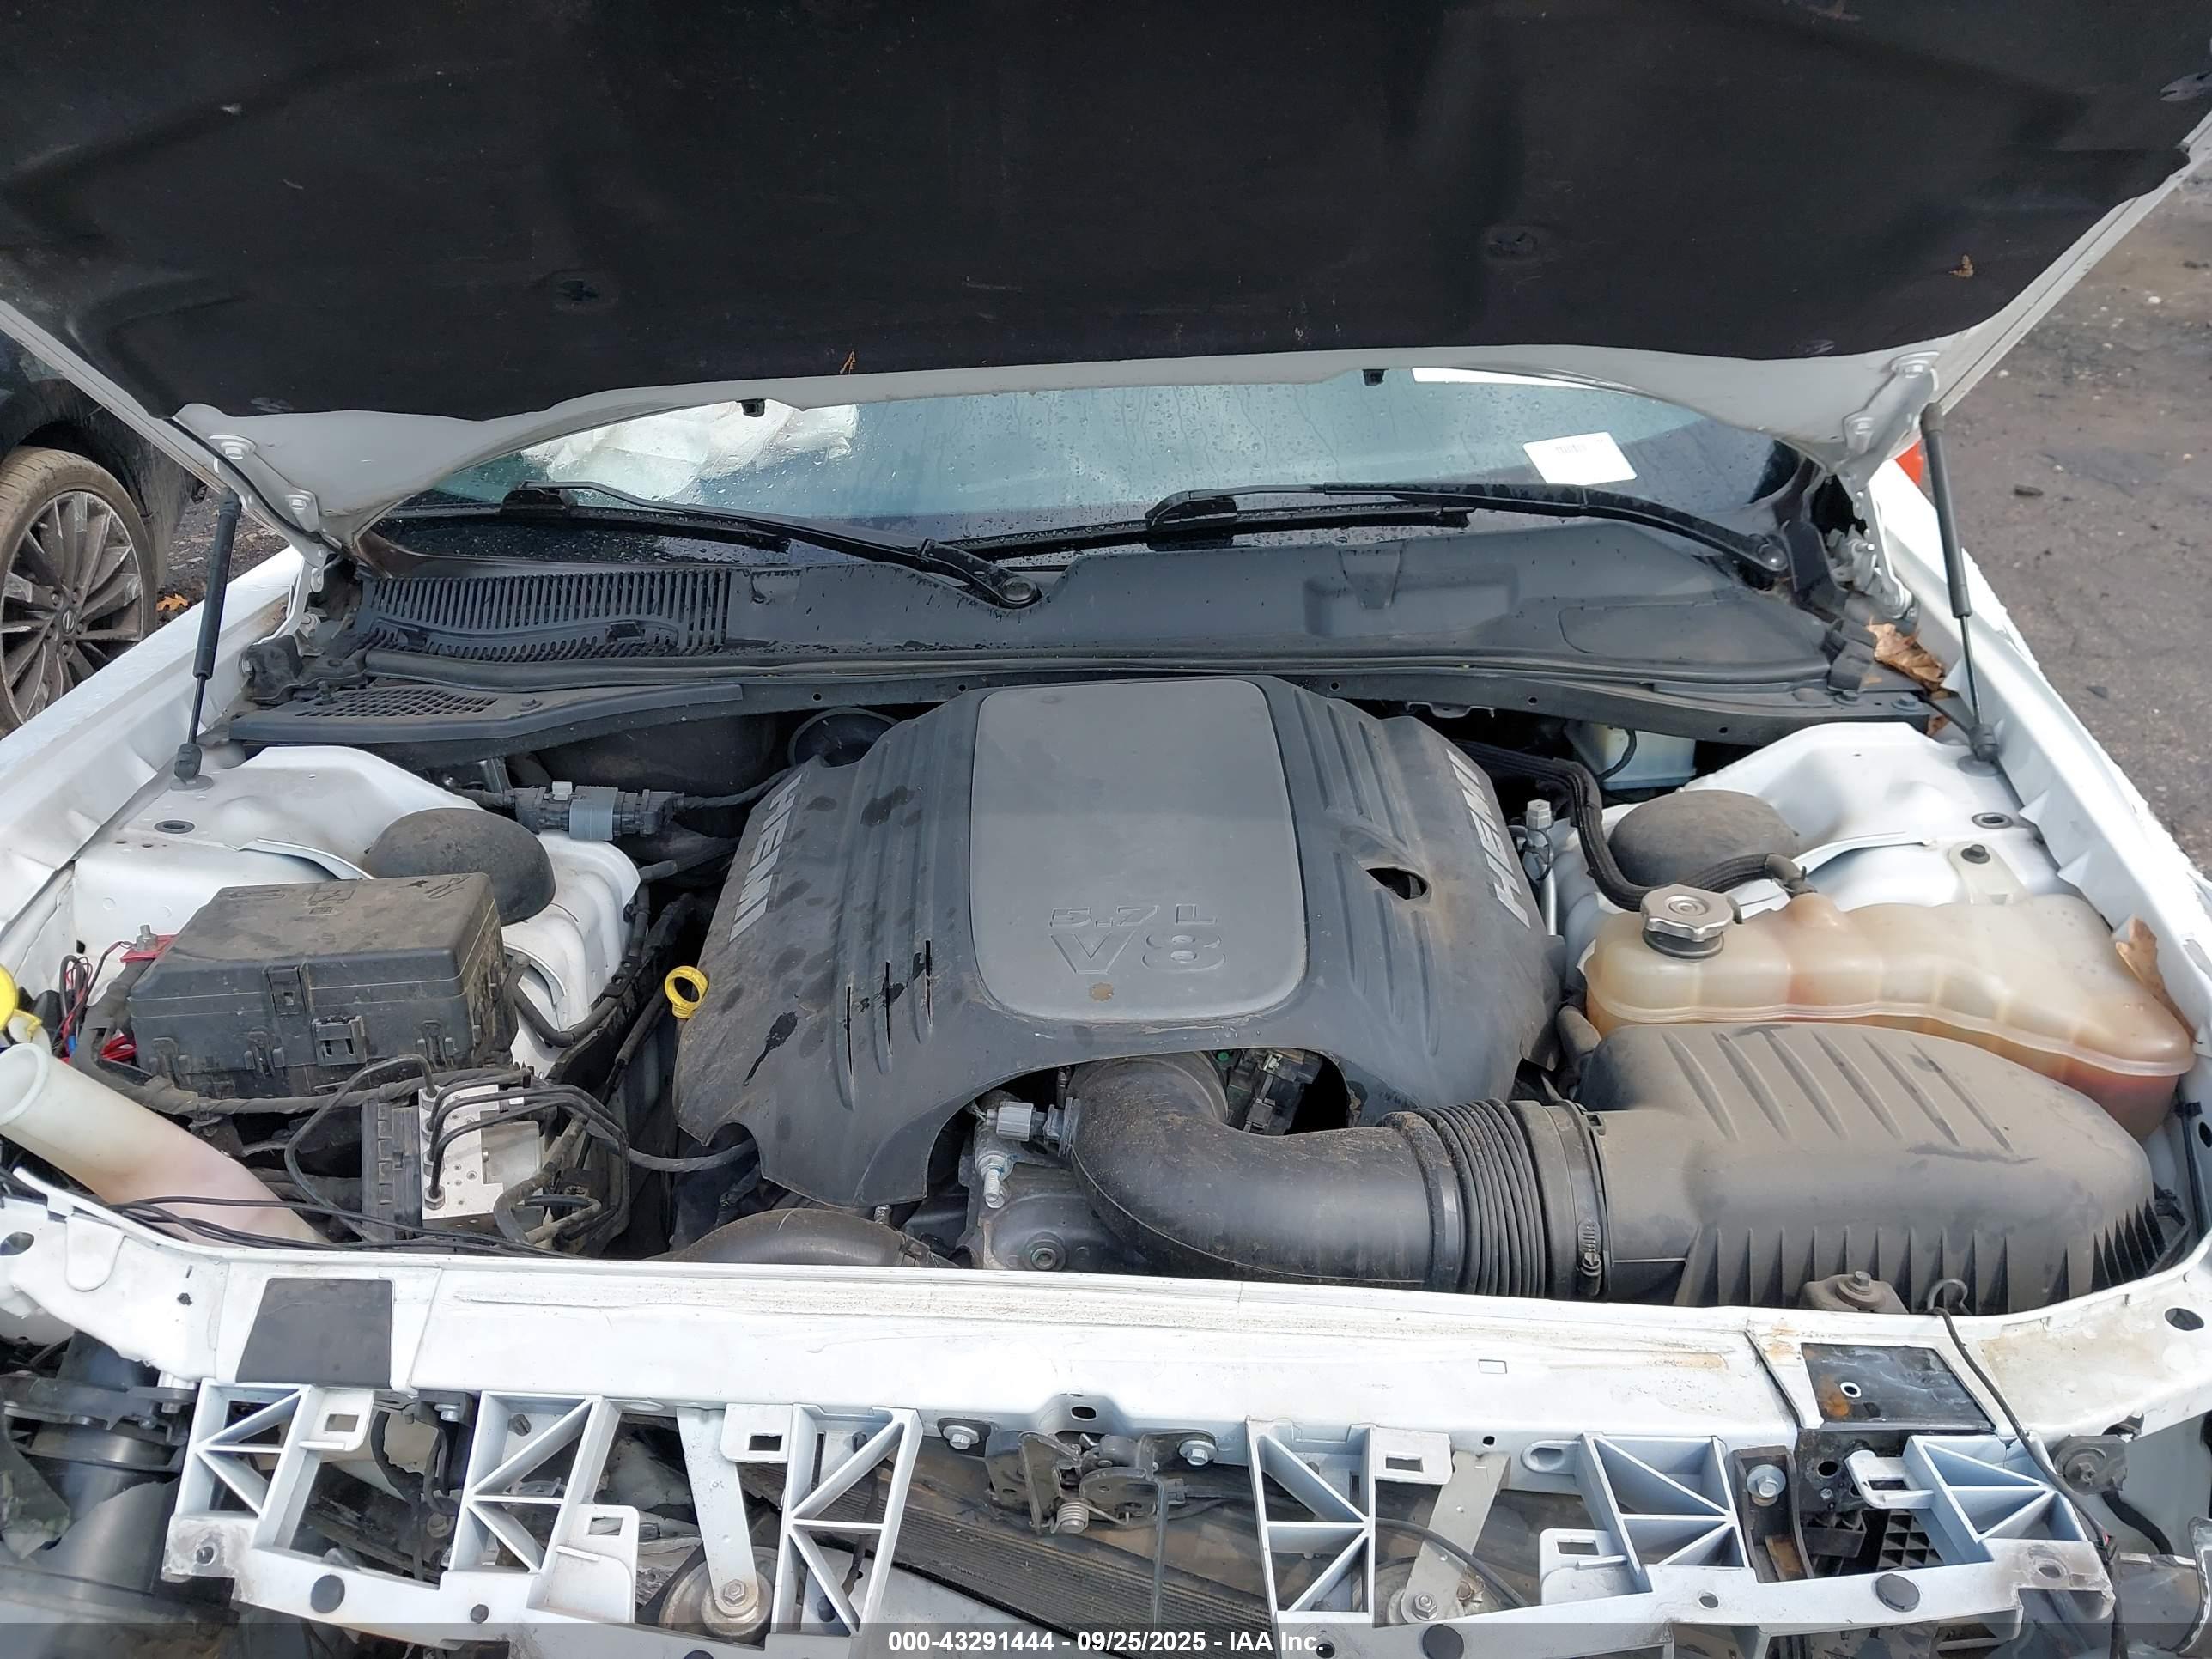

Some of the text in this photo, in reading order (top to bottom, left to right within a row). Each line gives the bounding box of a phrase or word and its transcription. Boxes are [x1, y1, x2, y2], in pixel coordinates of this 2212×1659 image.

[729, 775, 802, 943] HEMI
[1446, 749, 1531, 928] HEMI
[1049, 929, 1226, 974] V8
